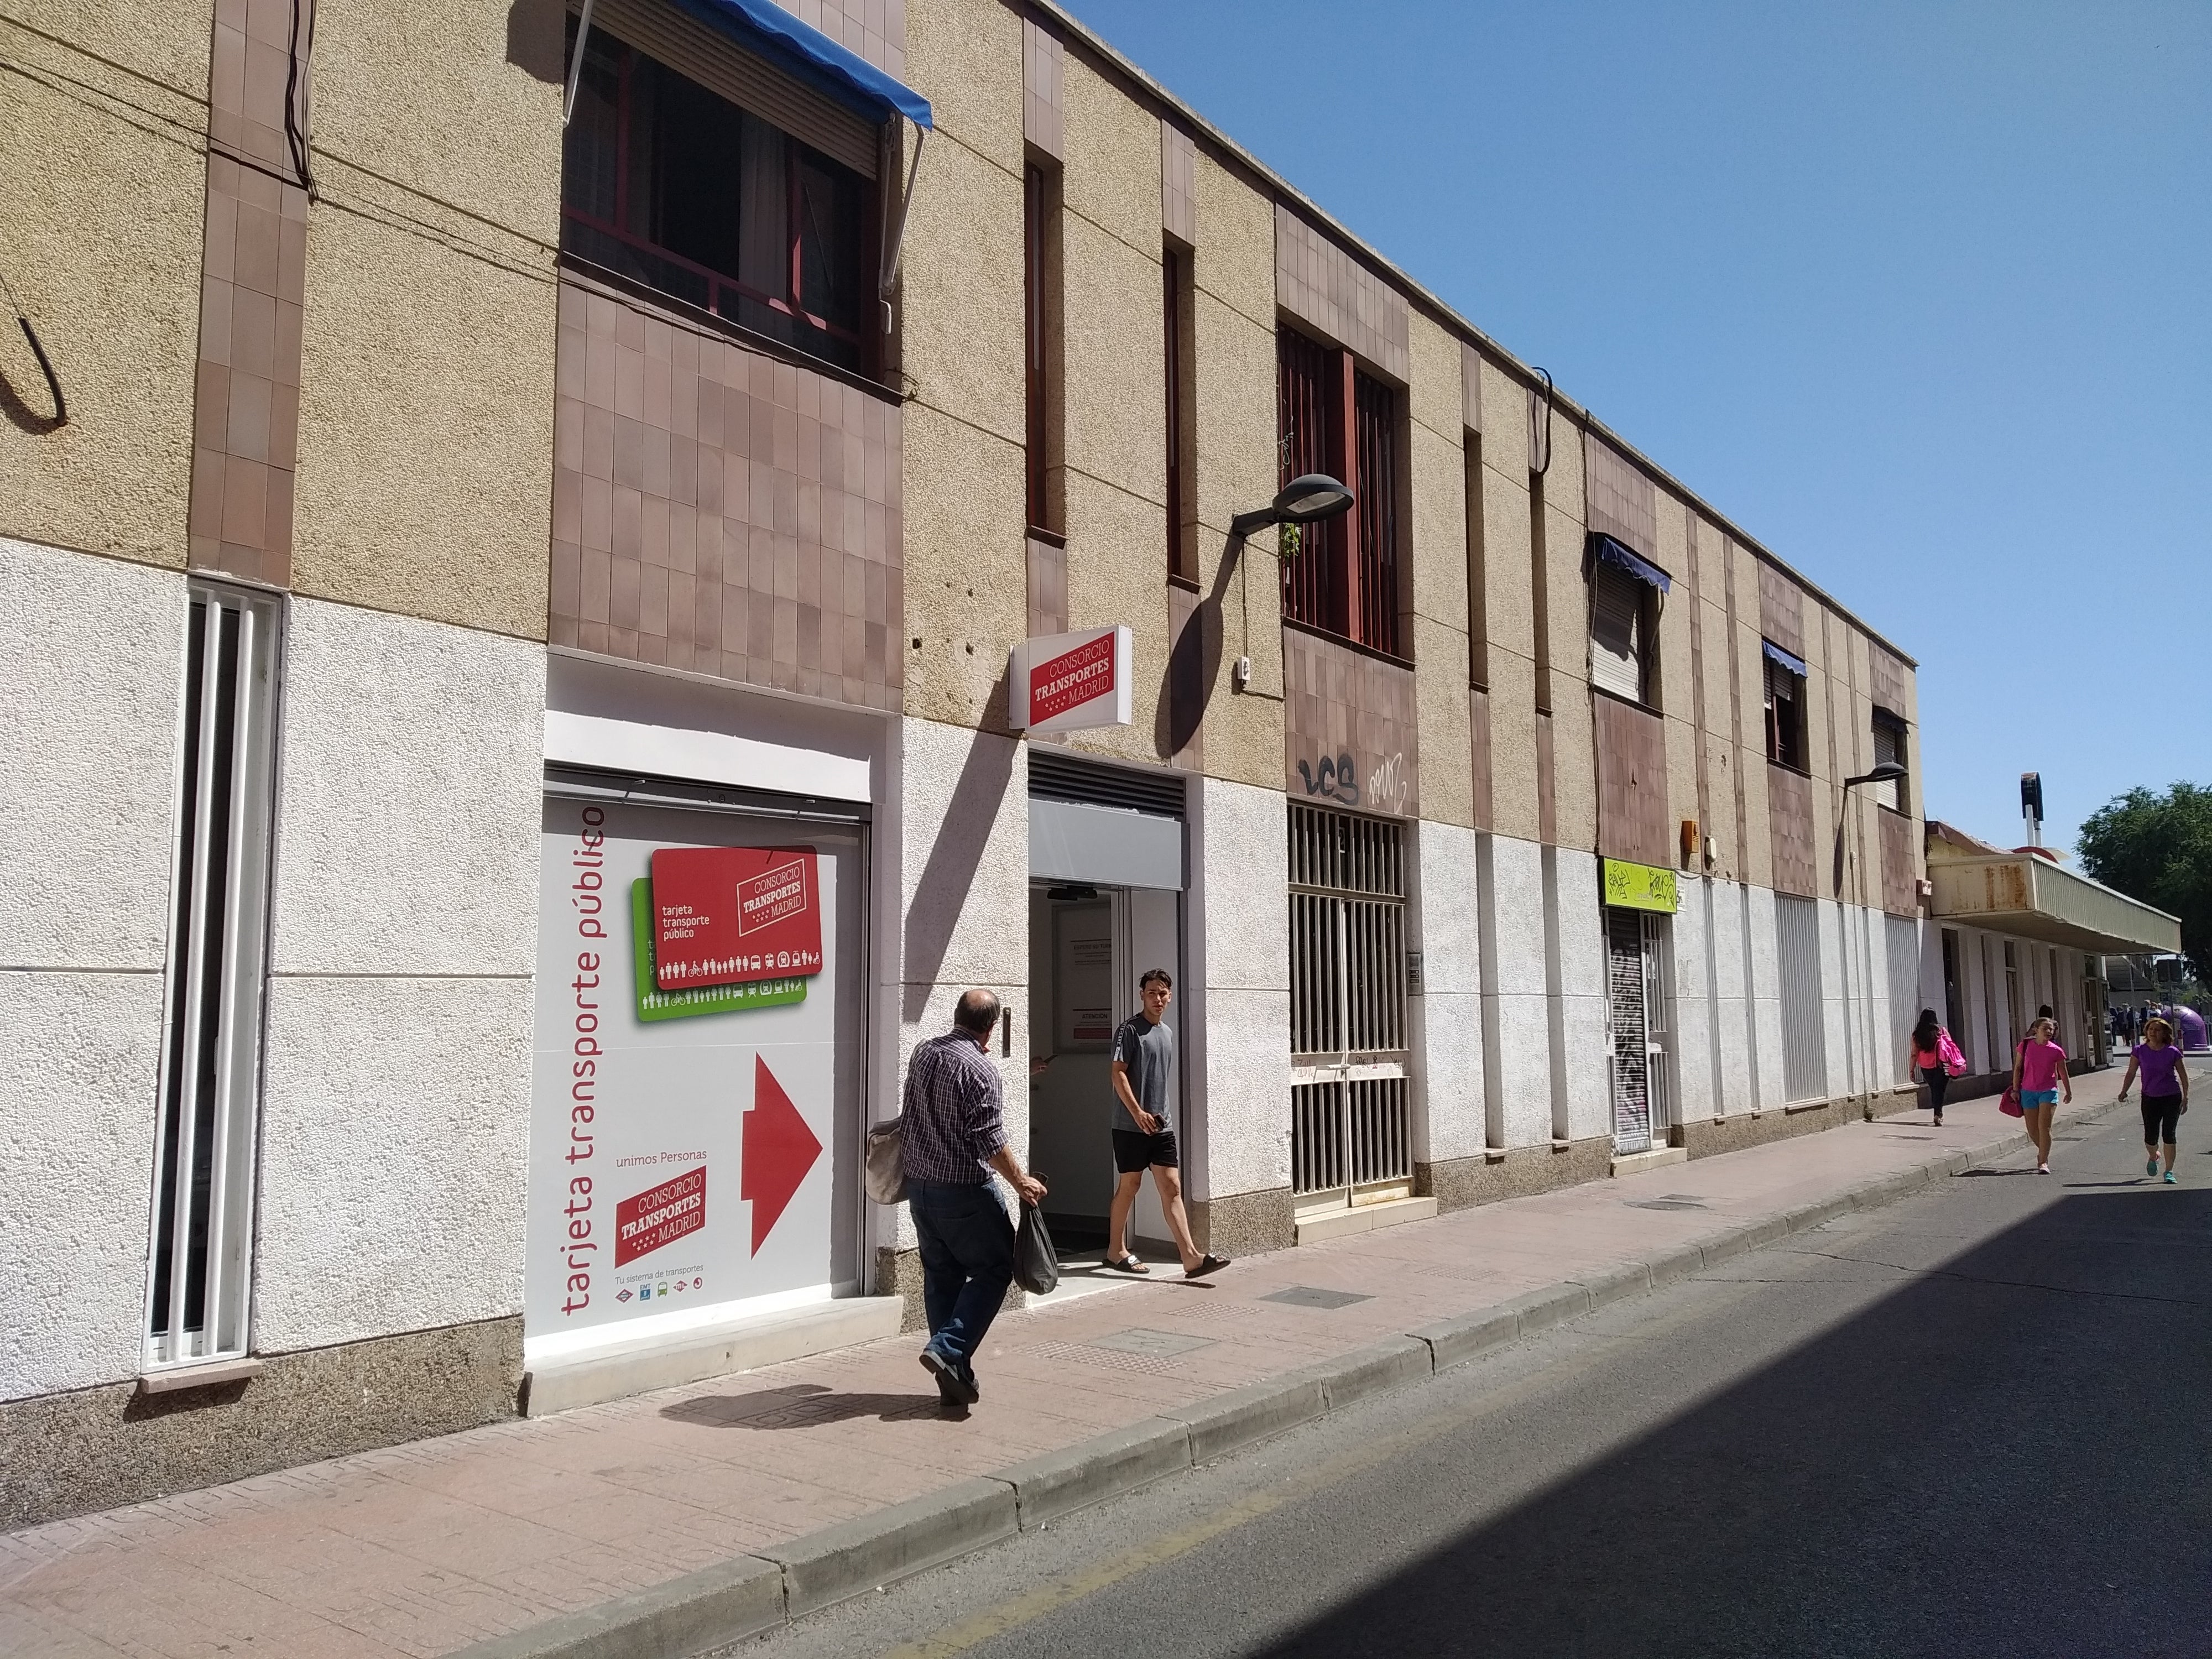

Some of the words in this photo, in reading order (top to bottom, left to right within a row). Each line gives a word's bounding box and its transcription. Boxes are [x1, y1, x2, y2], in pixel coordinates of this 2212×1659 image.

[1050, 640, 1109, 678] CONSORCIO
[1035, 658, 1109, 702] TRANSPORTES
[1068, 675, 1109, 705] MADRID
[572, 806, 608, 938] público
[754, 866, 800, 894] CONSORCIO
[662, 904, 692, 917] tarjeta
[743, 880, 801, 914] TRANSPORTES
[771, 895, 801, 918] MADRID
[662, 915, 709, 928] transporte
[664, 927, 694, 942] público
[565, 952, 603, 1165] transporte
[616, 1155, 658, 1168] unimos
[660, 1150, 707, 1164] Personas
[638, 1173, 701, 1213] CONSORCIO
[622, 1192, 701, 1241] TRANSPORTES
[658, 1211, 701, 1243] MADRID
[560, 1176, 598, 1317] tarjeta
[615, 1276, 625, 1285] Tu
[626, 1272, 653, 1284] sistema
[666, 1265, 704, 1277] transportes
